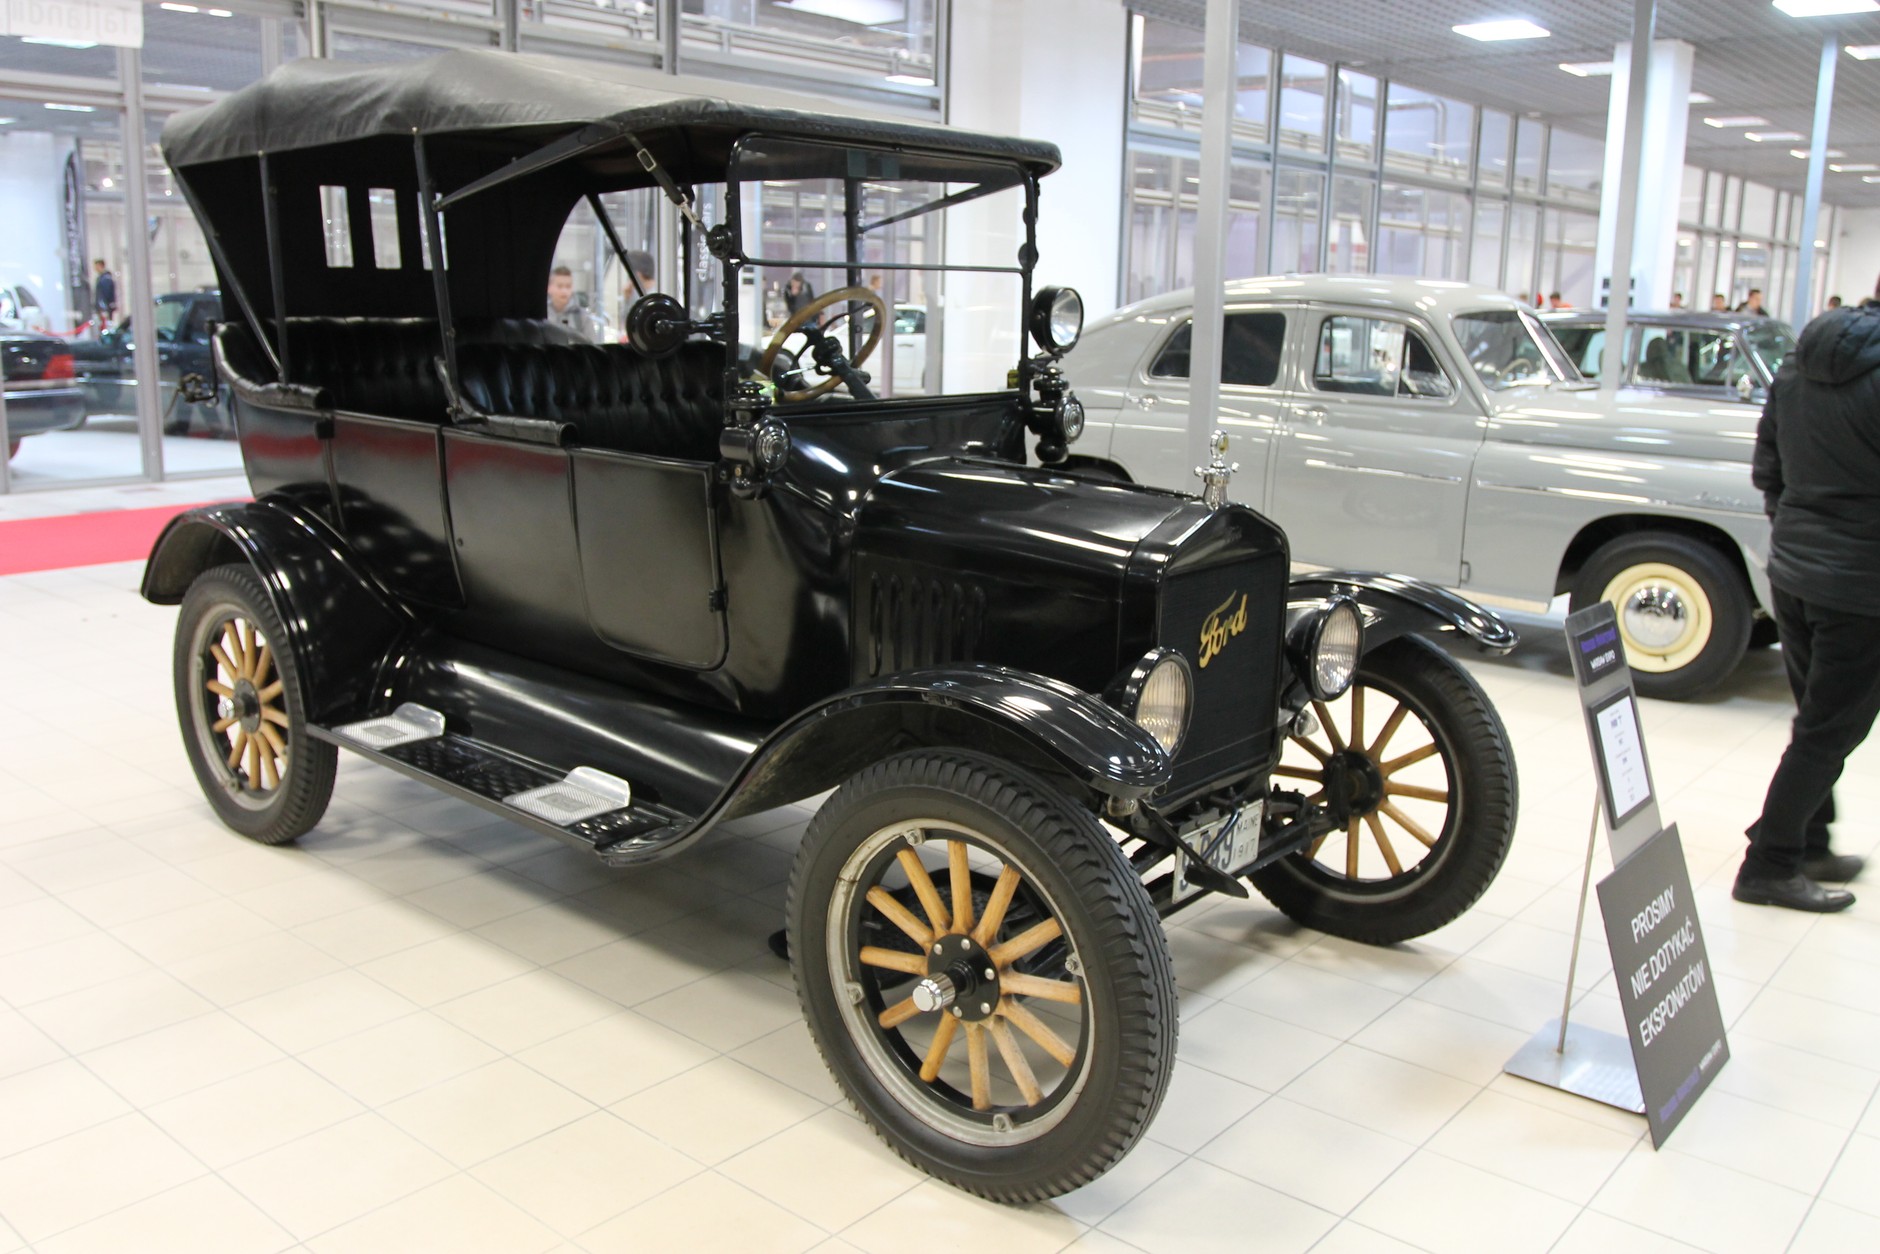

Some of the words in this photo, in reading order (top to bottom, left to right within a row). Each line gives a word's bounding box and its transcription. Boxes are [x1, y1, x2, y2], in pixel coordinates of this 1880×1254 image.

[1199, 590, 1248, 668] Ford
[1631, 885, 1676, 944] PROSIMY
[1630, 963, 1652, 1000] NIE
[1649, 915, 1695, 981] DOTYKAĆ
[1639, 960, 1706, 1047] EKSPONATÓW
